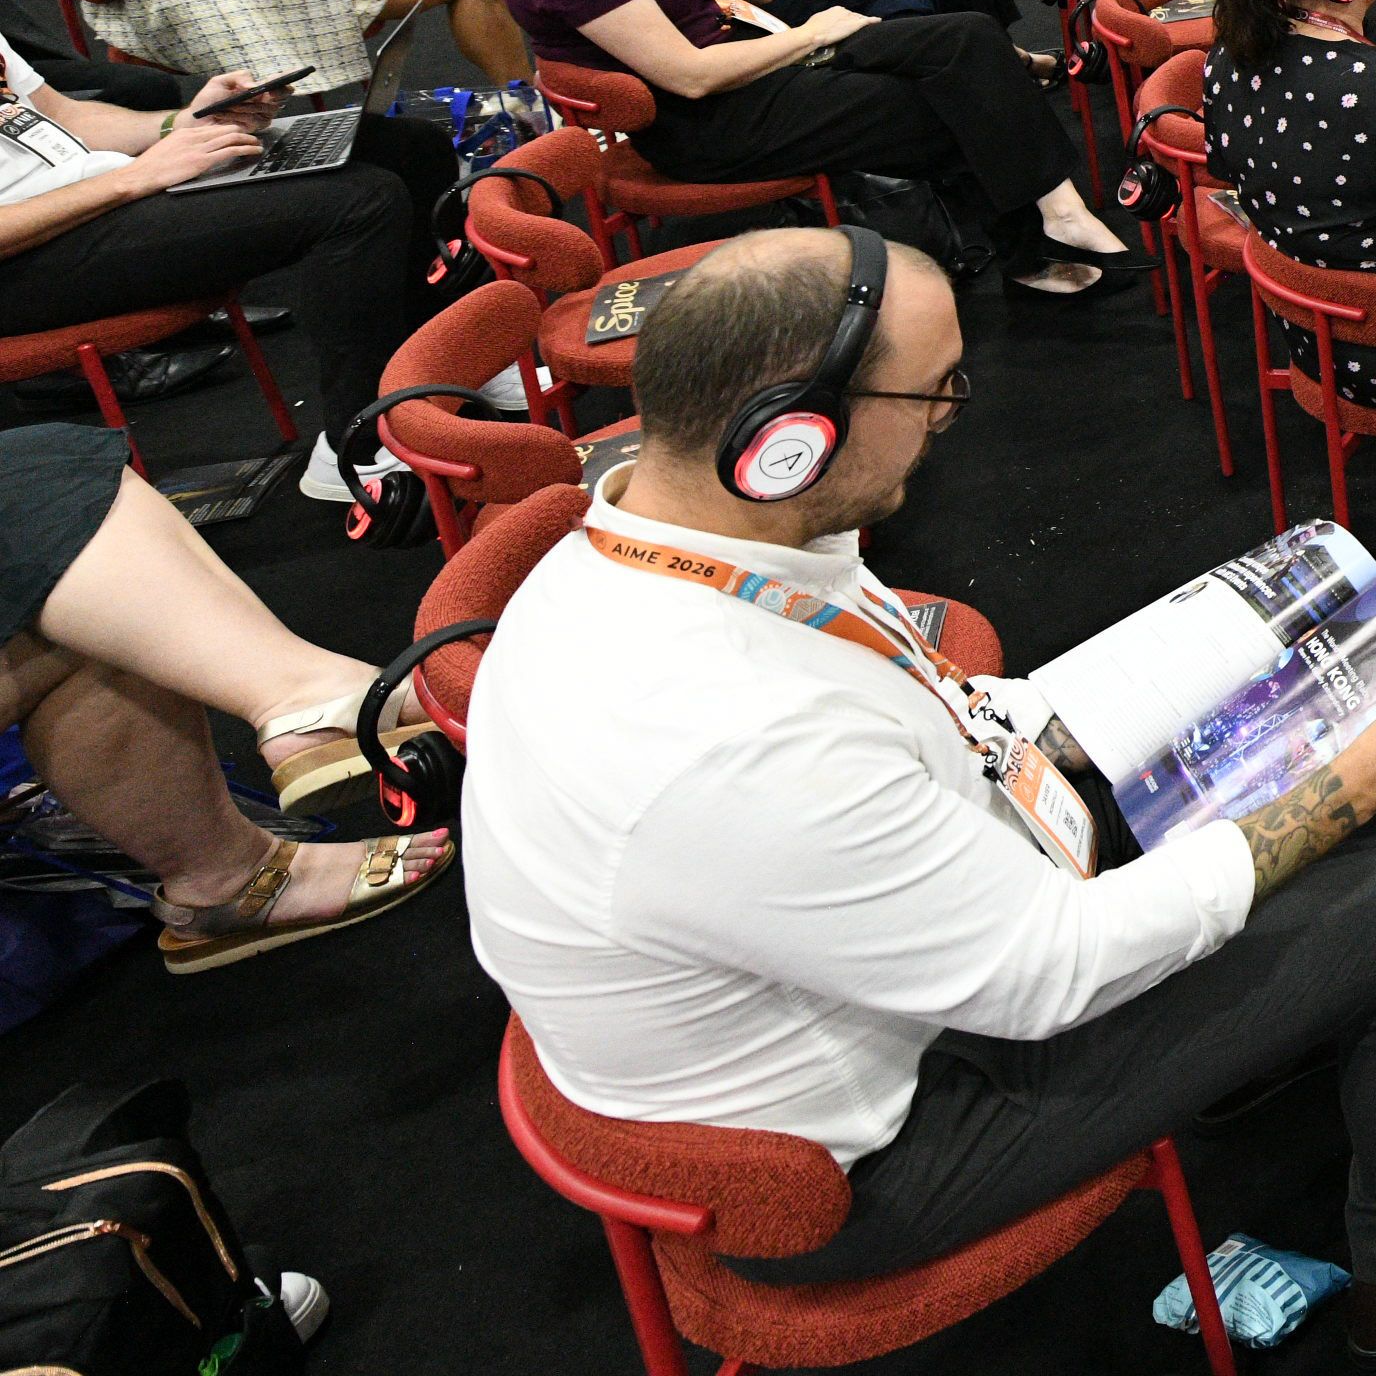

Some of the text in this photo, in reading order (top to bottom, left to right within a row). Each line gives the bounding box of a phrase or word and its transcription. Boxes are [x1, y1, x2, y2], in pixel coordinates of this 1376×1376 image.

[595, 282, 645, 332] Spice
[612, 543, 716, 578] AIME 2026
[1306, 636, 1360, 710] HONG KONG
